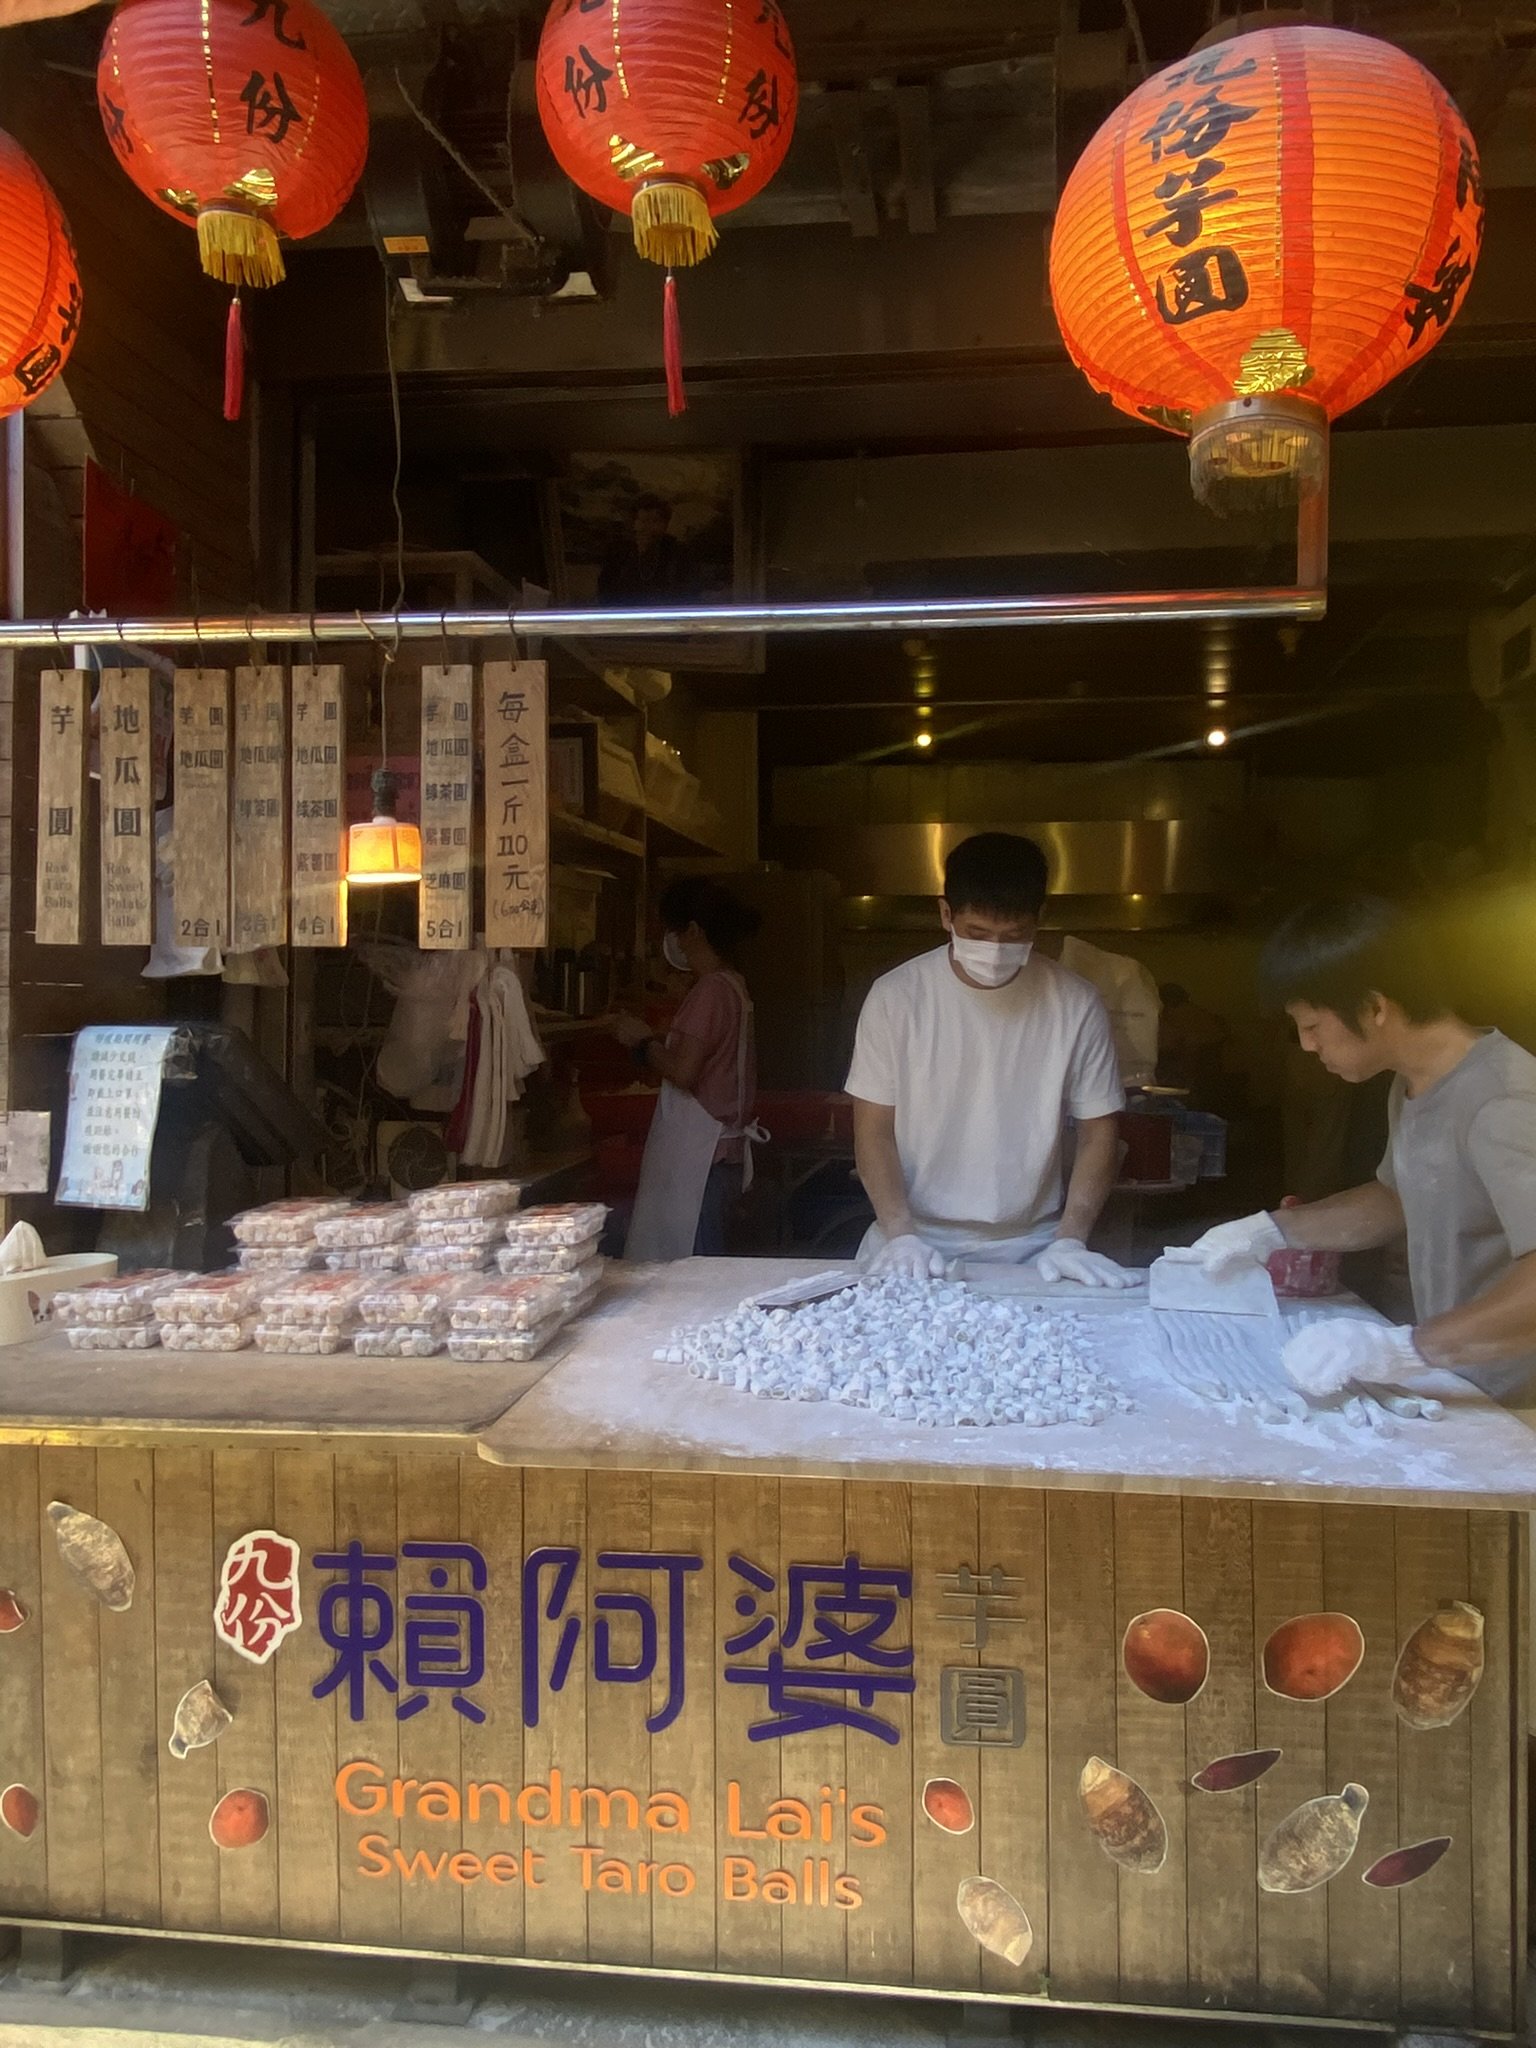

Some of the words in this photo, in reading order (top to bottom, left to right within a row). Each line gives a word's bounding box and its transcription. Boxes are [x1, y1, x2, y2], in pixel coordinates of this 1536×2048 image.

[1139, 46, 1260, 325] 九份芋圓
[296, 745, 337, 765] 地瓜圓
[426, 738, 468, 757] 地瓜圓
[180, 750, 223, 769] 地瓜圓
[49, 704, 74, 837] 芋圓
[113, 704, 141, 837] 地瓜圓
[45, 862, 69, 874] Raw
[107, 862, 131, 874] Raw
[107, 879, 144, 892] Sweet
[45, 895, 73, 908] Balls
[181, 918, 220, 938] 2合1
[426, 920, 463, 940] 5合1
[225, 1540, 293, 1646] 九份
[312, 1540, 916, 1745] 賴阿婆
[936, 1565, 1027, 1749] 芋圓
[335, 1761, 690, 1834] Grandma
[727, 1780, 888, 1849] Lai's
[357, 1834, 546, 1889] Sweet
[569, 1844, 696, 1897] Taro
[723, 1855, 863, 1911] Balls
